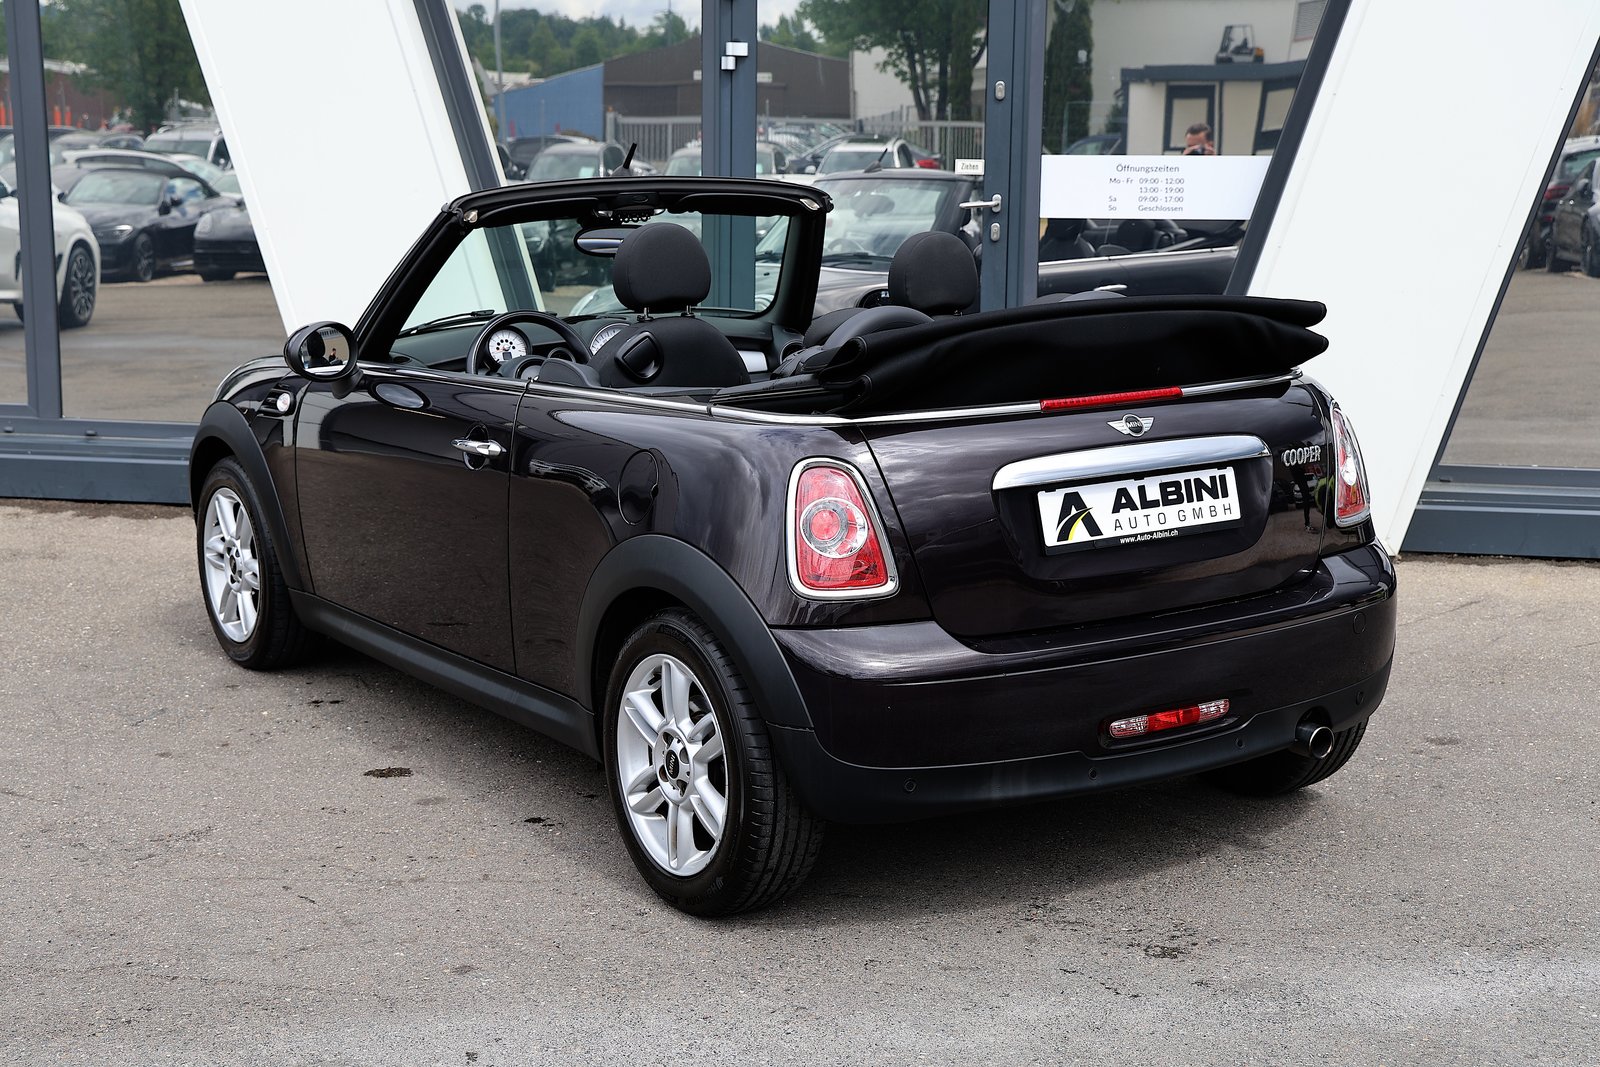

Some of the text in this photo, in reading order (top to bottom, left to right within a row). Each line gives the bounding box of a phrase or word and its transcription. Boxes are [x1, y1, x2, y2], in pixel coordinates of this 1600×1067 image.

[961, 162, 979, 170] Ziehen
[1116, 163, 1180, 174] Öffnungszeiten
[1138, 204, 1184, 212] Geschlossen
[1283, 445, 1321, 467] COOPER
[1112, 474, 1229, 514] ALBINI
[1114, 503, 1232, 531] AUTO GMBH
[1120, 529, 1179, 544] www.Auto-Albini.ch
